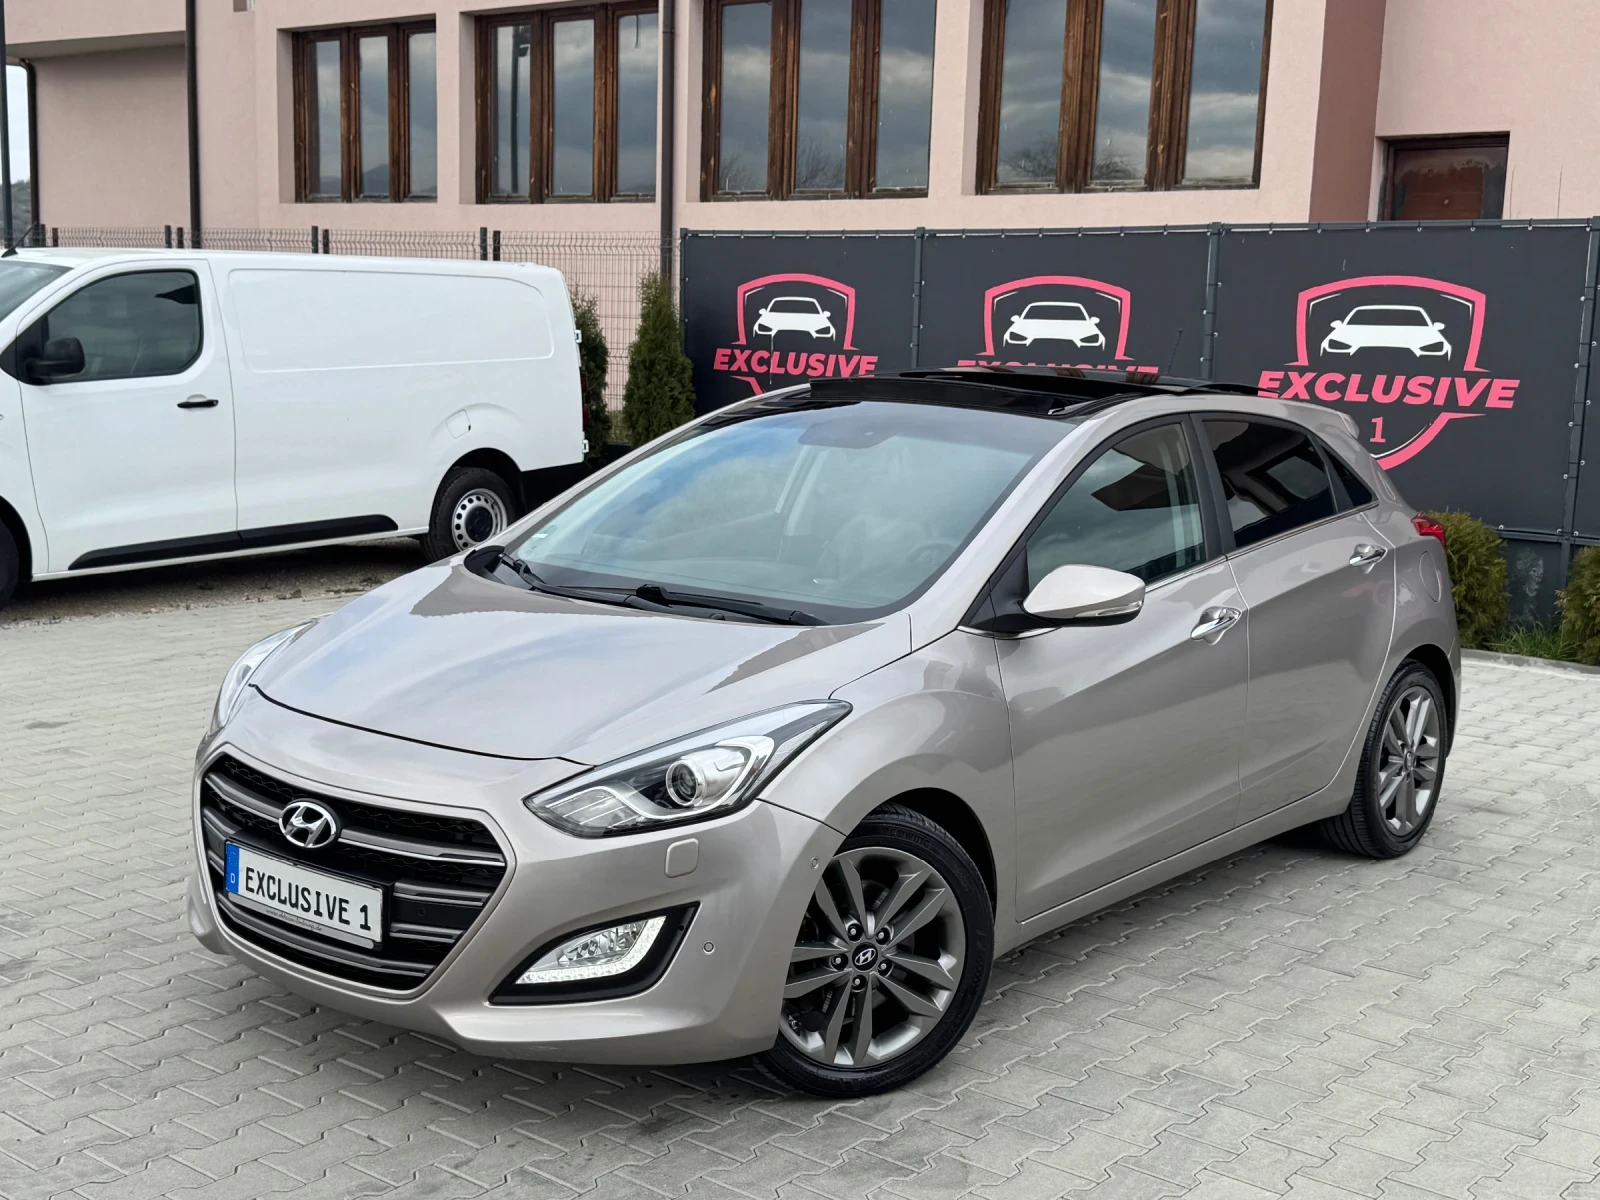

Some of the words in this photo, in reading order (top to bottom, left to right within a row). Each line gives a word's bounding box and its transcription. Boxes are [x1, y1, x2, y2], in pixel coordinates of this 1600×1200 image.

[713, 348, 878, 377] EXCLUSIVE
[1257, 370, 1520, 408] EXCLUSIVE
[1369, 416, 1386, 443] 1
[230, 872, 236, 884] D
[245, 866, 351, 926] EXCLUSIVE
[359, 904, 371, 932] 1
